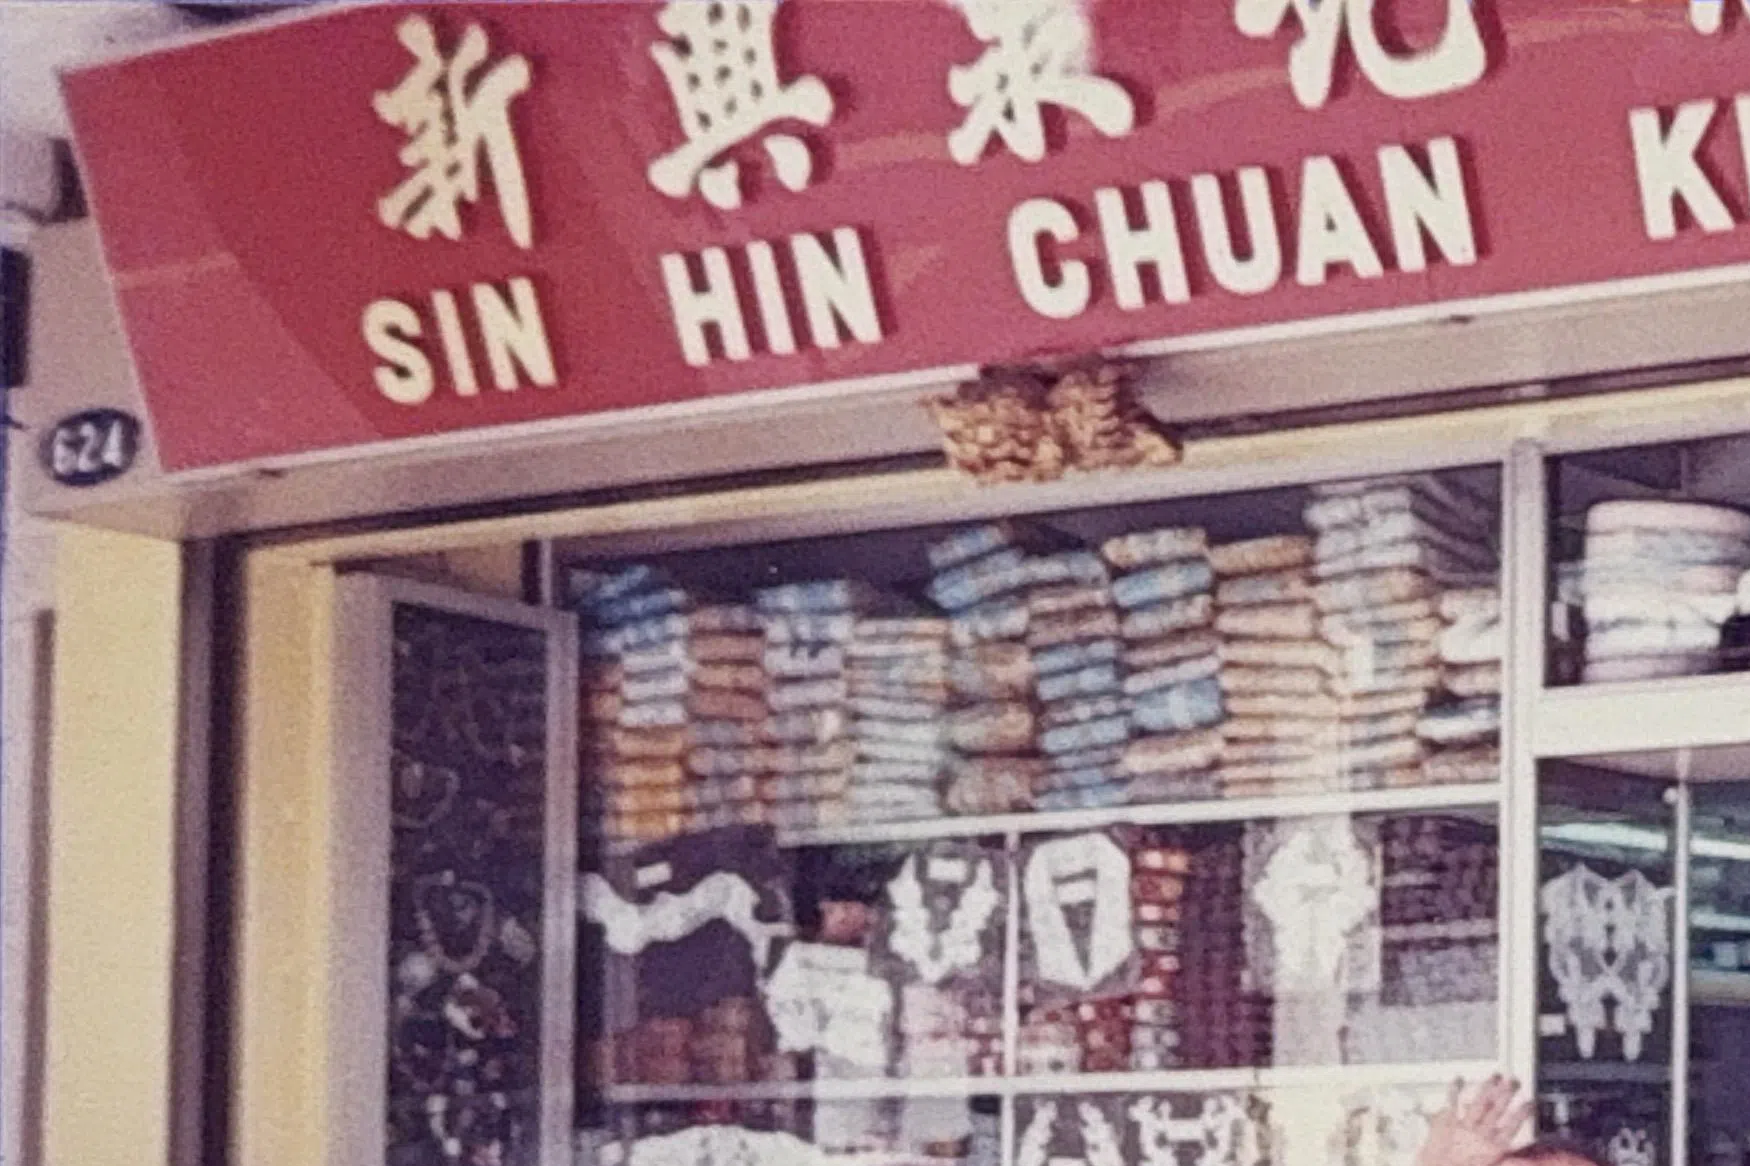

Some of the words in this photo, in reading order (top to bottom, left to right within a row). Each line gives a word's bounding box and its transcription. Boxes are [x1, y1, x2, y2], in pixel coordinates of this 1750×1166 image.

[364, 278, 556, 404] SIN
[661, 227, 881, 367] HIN
[1007, 136, 1477, 319] CHUAN
[53, 420, 122, 475] 624
